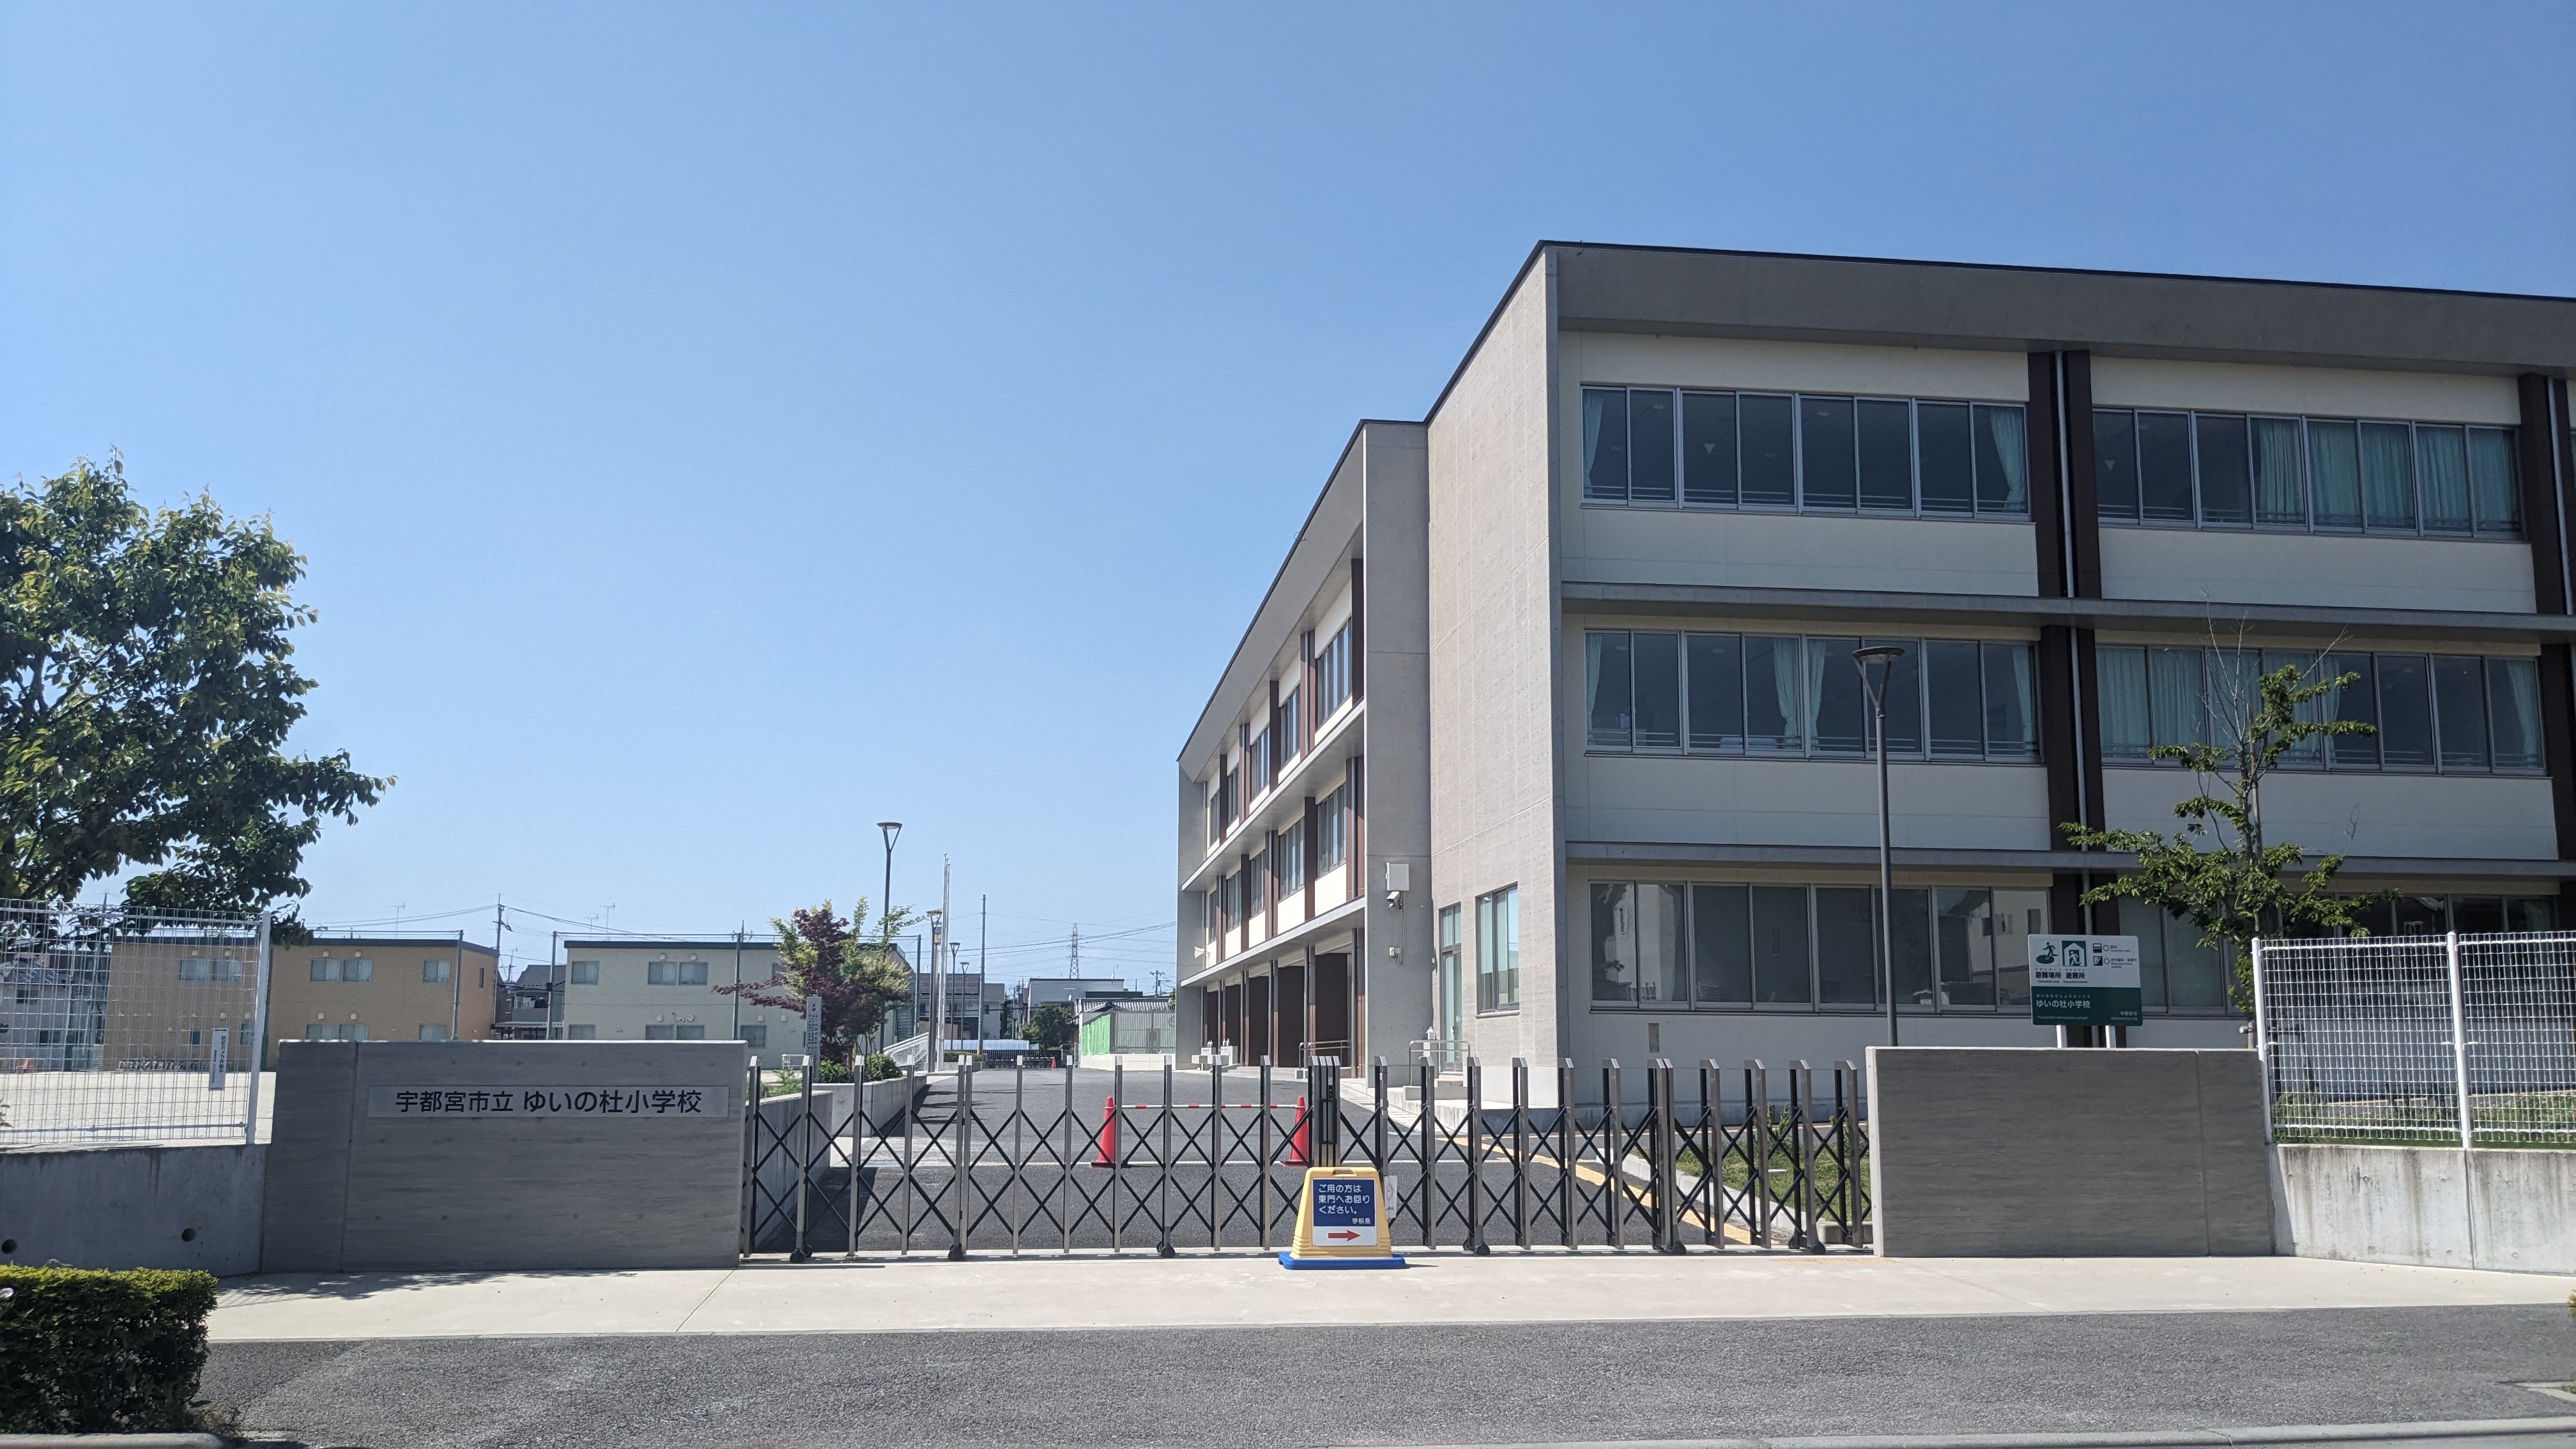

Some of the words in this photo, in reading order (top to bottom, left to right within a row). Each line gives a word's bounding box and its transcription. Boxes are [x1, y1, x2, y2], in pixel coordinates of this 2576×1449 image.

[2036, 1000, 2090, 1008] ゆいの杜小学校
[395, 1089, 514, 1114] 宇都宮市立
[523, 1089, 703, 1114] ゆいの杜小学校
[1318, 1184, 1361, 1193] ご用の方は
[1318, 1195, 1370, 1204] 東門へお回り
[1319, 1206, 1358, 1215] ください。
